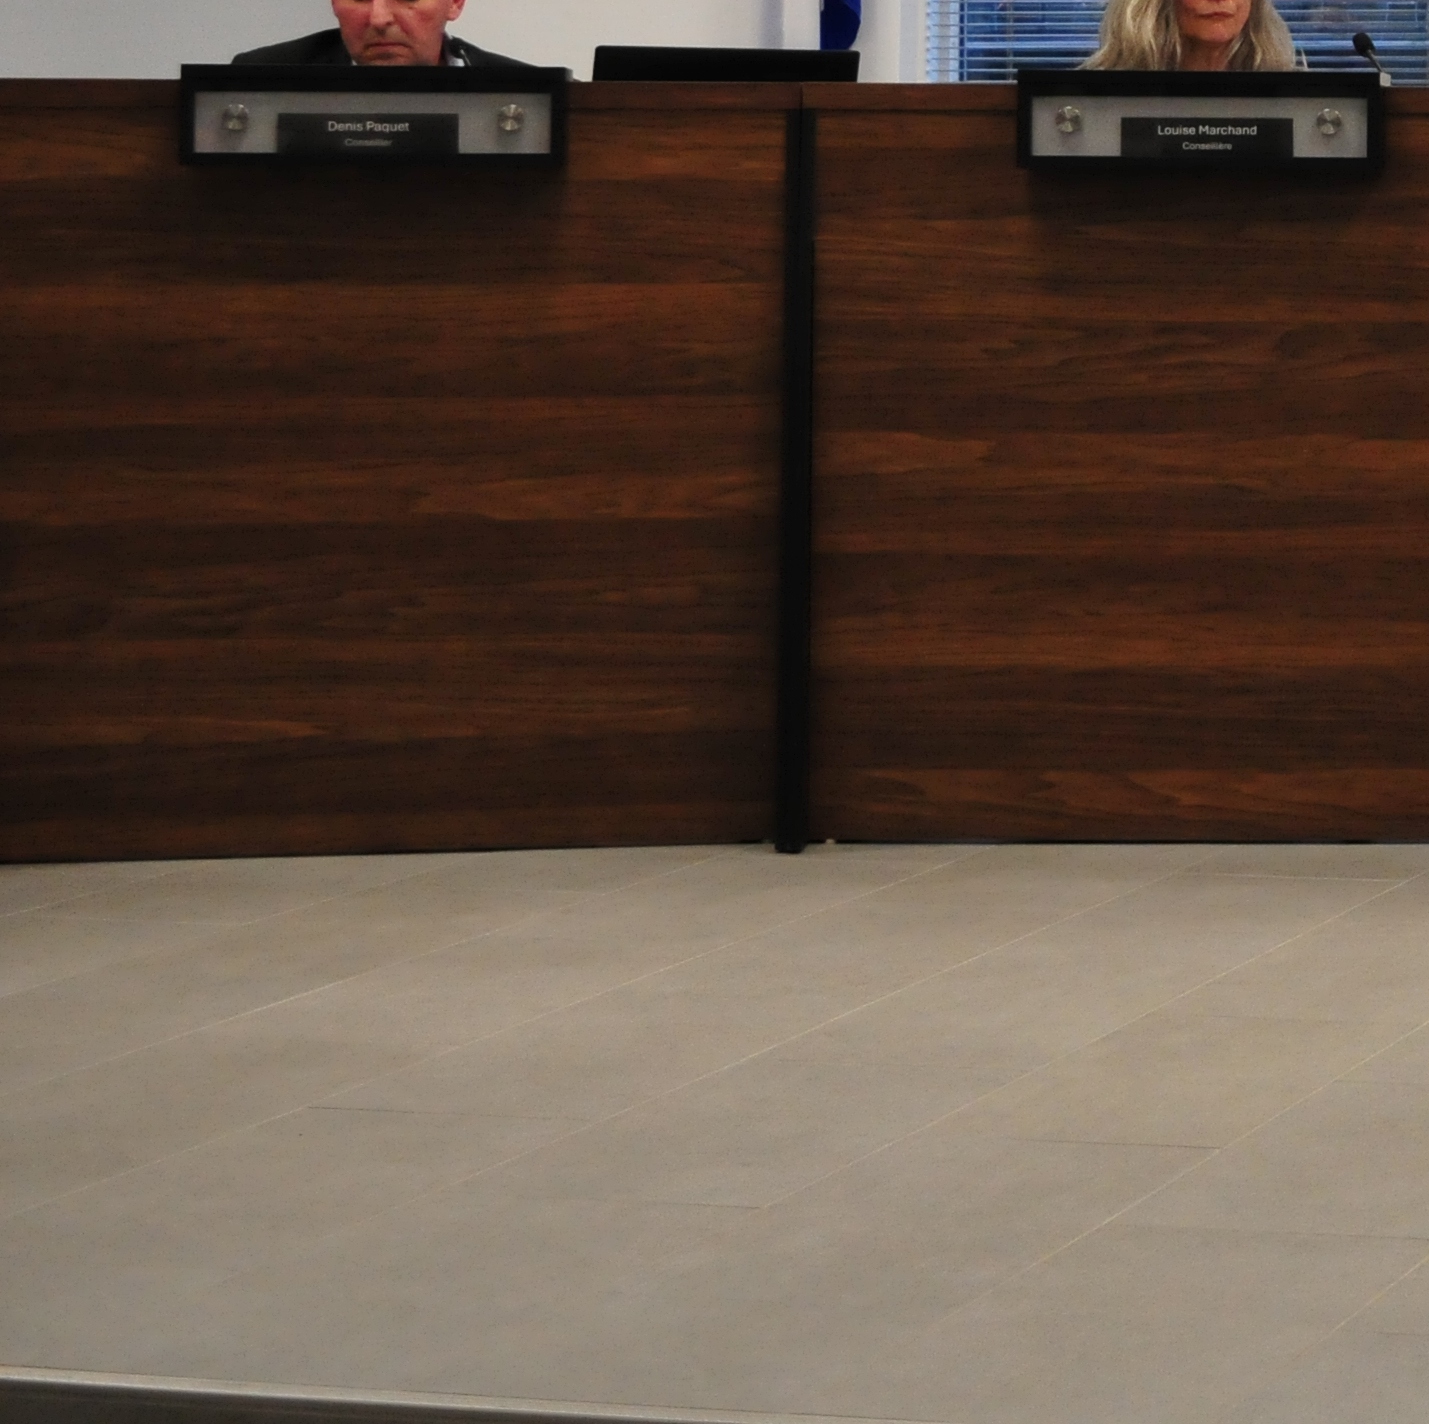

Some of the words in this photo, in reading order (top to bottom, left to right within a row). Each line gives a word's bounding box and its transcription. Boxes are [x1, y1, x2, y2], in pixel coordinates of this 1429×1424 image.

[327, 120, 363, 132] Denis
[365, 120, 410, 133] Paquet
[1157, 124, 1196, 135] Louise
[1198, 124, 1258, 135] Marchand
